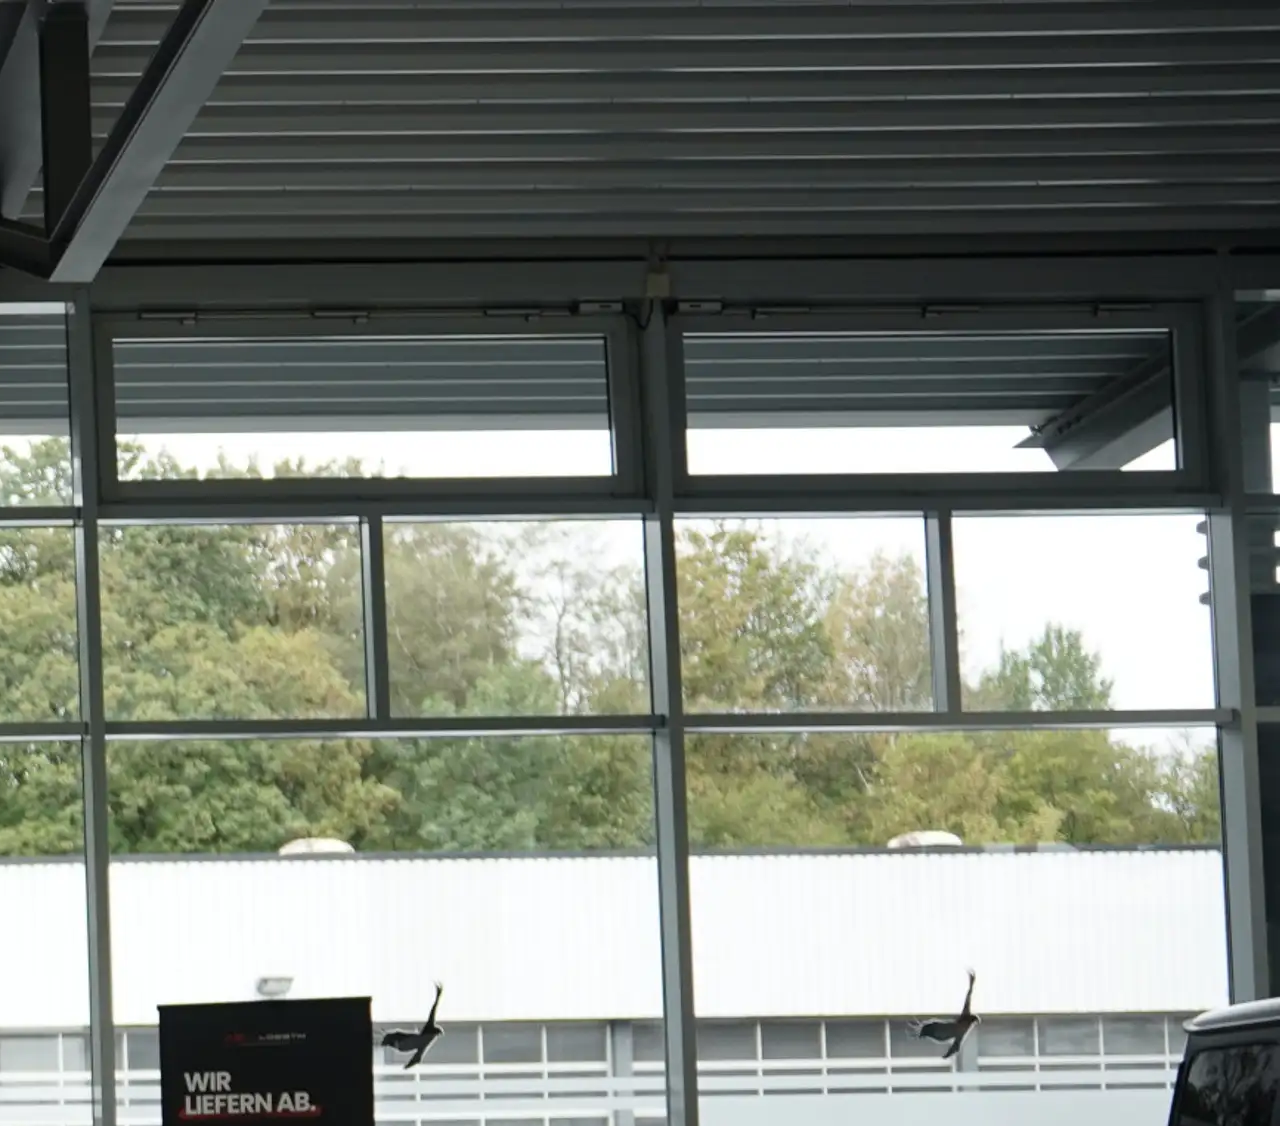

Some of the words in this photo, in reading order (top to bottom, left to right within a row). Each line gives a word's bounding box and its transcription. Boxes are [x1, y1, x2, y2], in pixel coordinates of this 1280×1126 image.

[184, 1071, 231, 1092] WIR
[185, 1093, 273, 1116] LIEFERN
[277, 1092, 317, 1112] AB.
